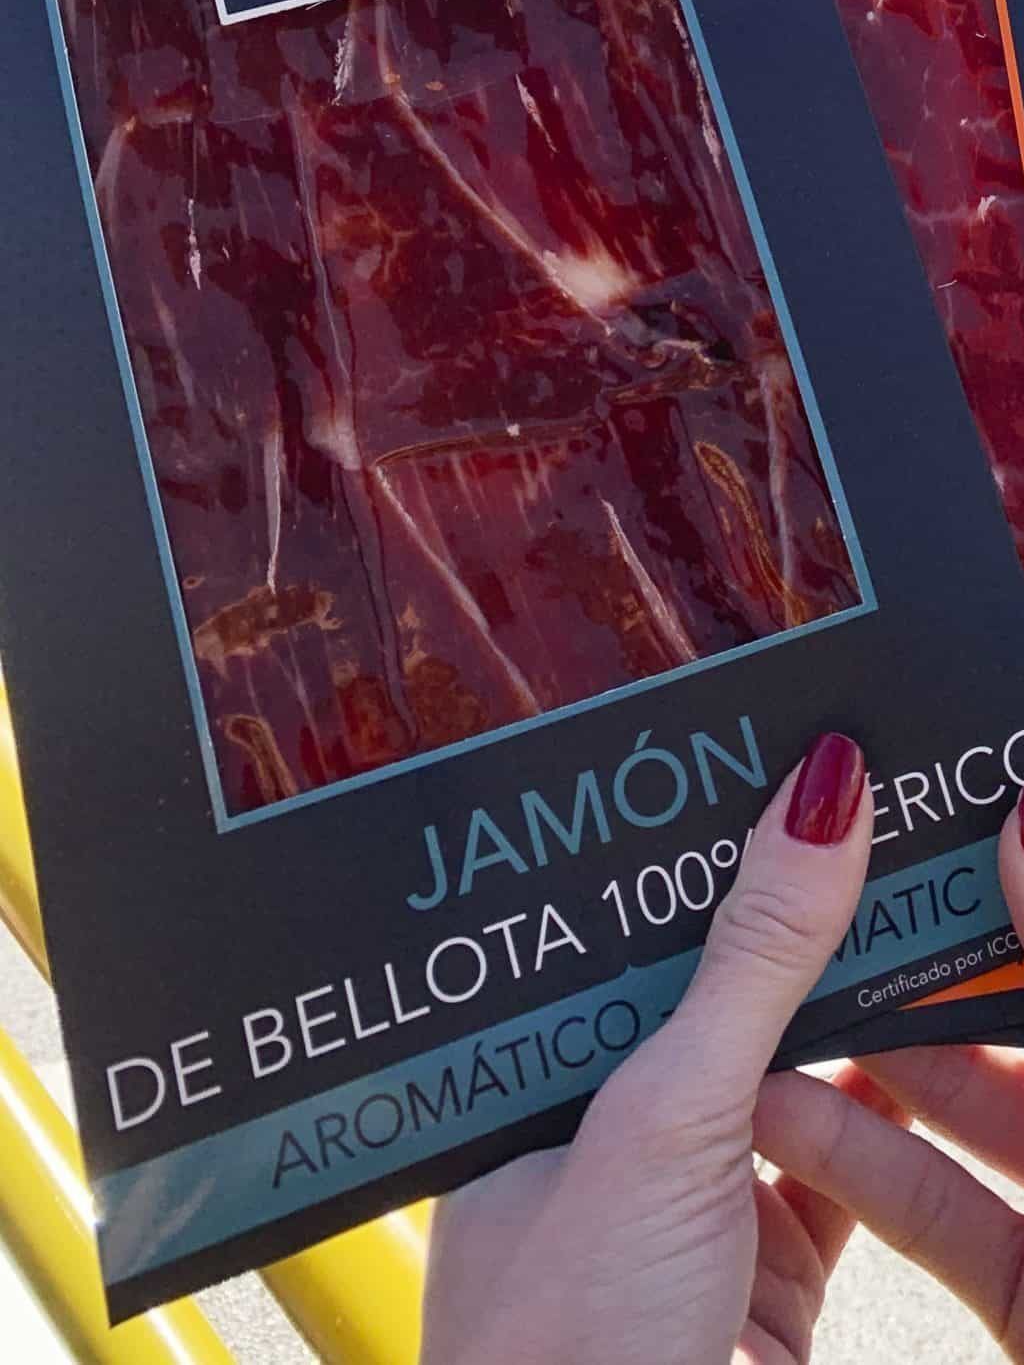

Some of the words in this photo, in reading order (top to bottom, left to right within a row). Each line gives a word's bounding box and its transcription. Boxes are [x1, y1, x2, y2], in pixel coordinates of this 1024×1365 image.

[406, 715, 768, 911] JAMÓN
[106, 1031, 221, 1130] DE
[243, 904, 586, 1080] BELLOTA
[857, 962, 950, 1008] Certificado
[955, 949, 983, 975] por
[272, 999, 641, 1189] AROMÁTICO
